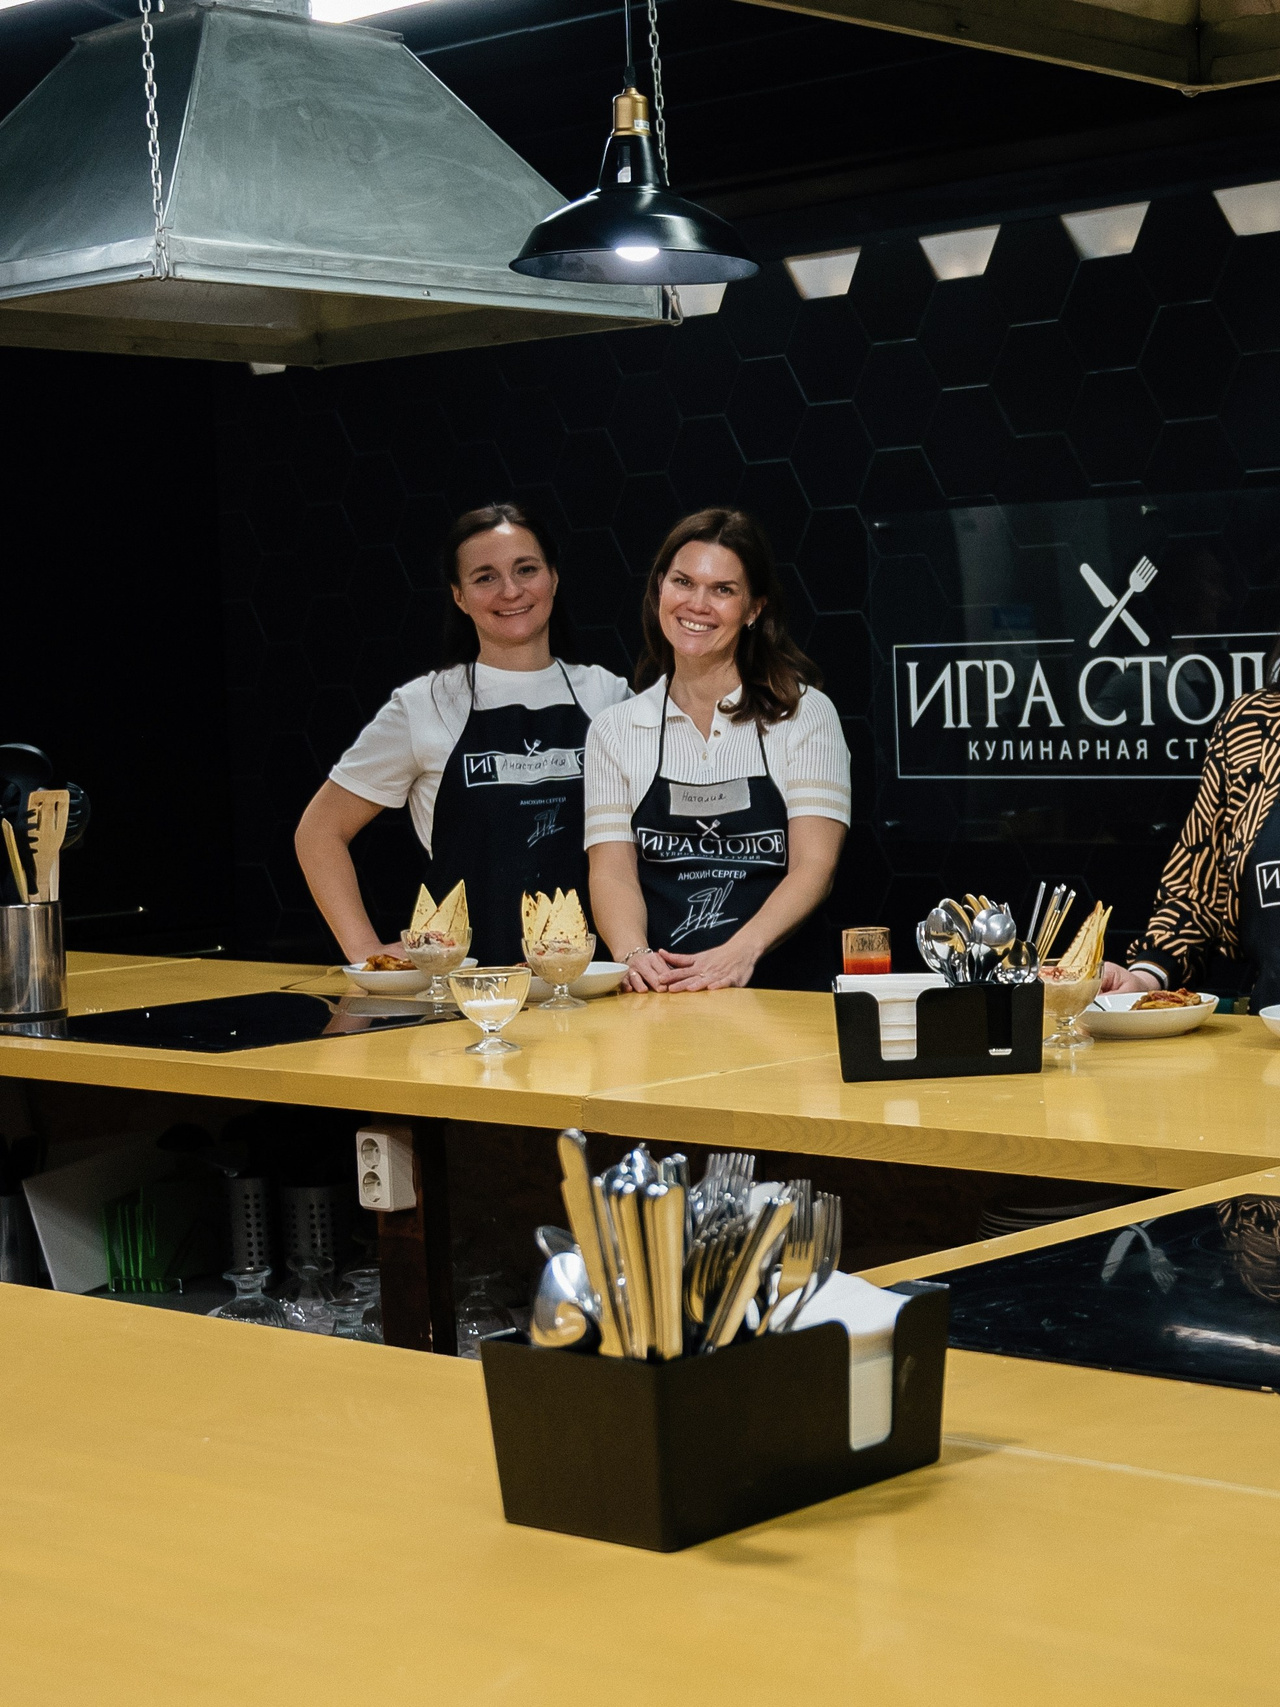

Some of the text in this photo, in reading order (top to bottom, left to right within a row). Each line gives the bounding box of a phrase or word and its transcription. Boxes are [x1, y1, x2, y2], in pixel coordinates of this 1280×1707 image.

[907, 660, 1065, 728] ИГРА
[968, 739, 1149, 760] КУЛИНАРНАЯ
[682, 790, 727, 803] Наталия
[641, 833, 784, 855] ИГРА СТОЛОВ
[678, 869, 747, 881] АНОХИН СЕРГЕЙ
